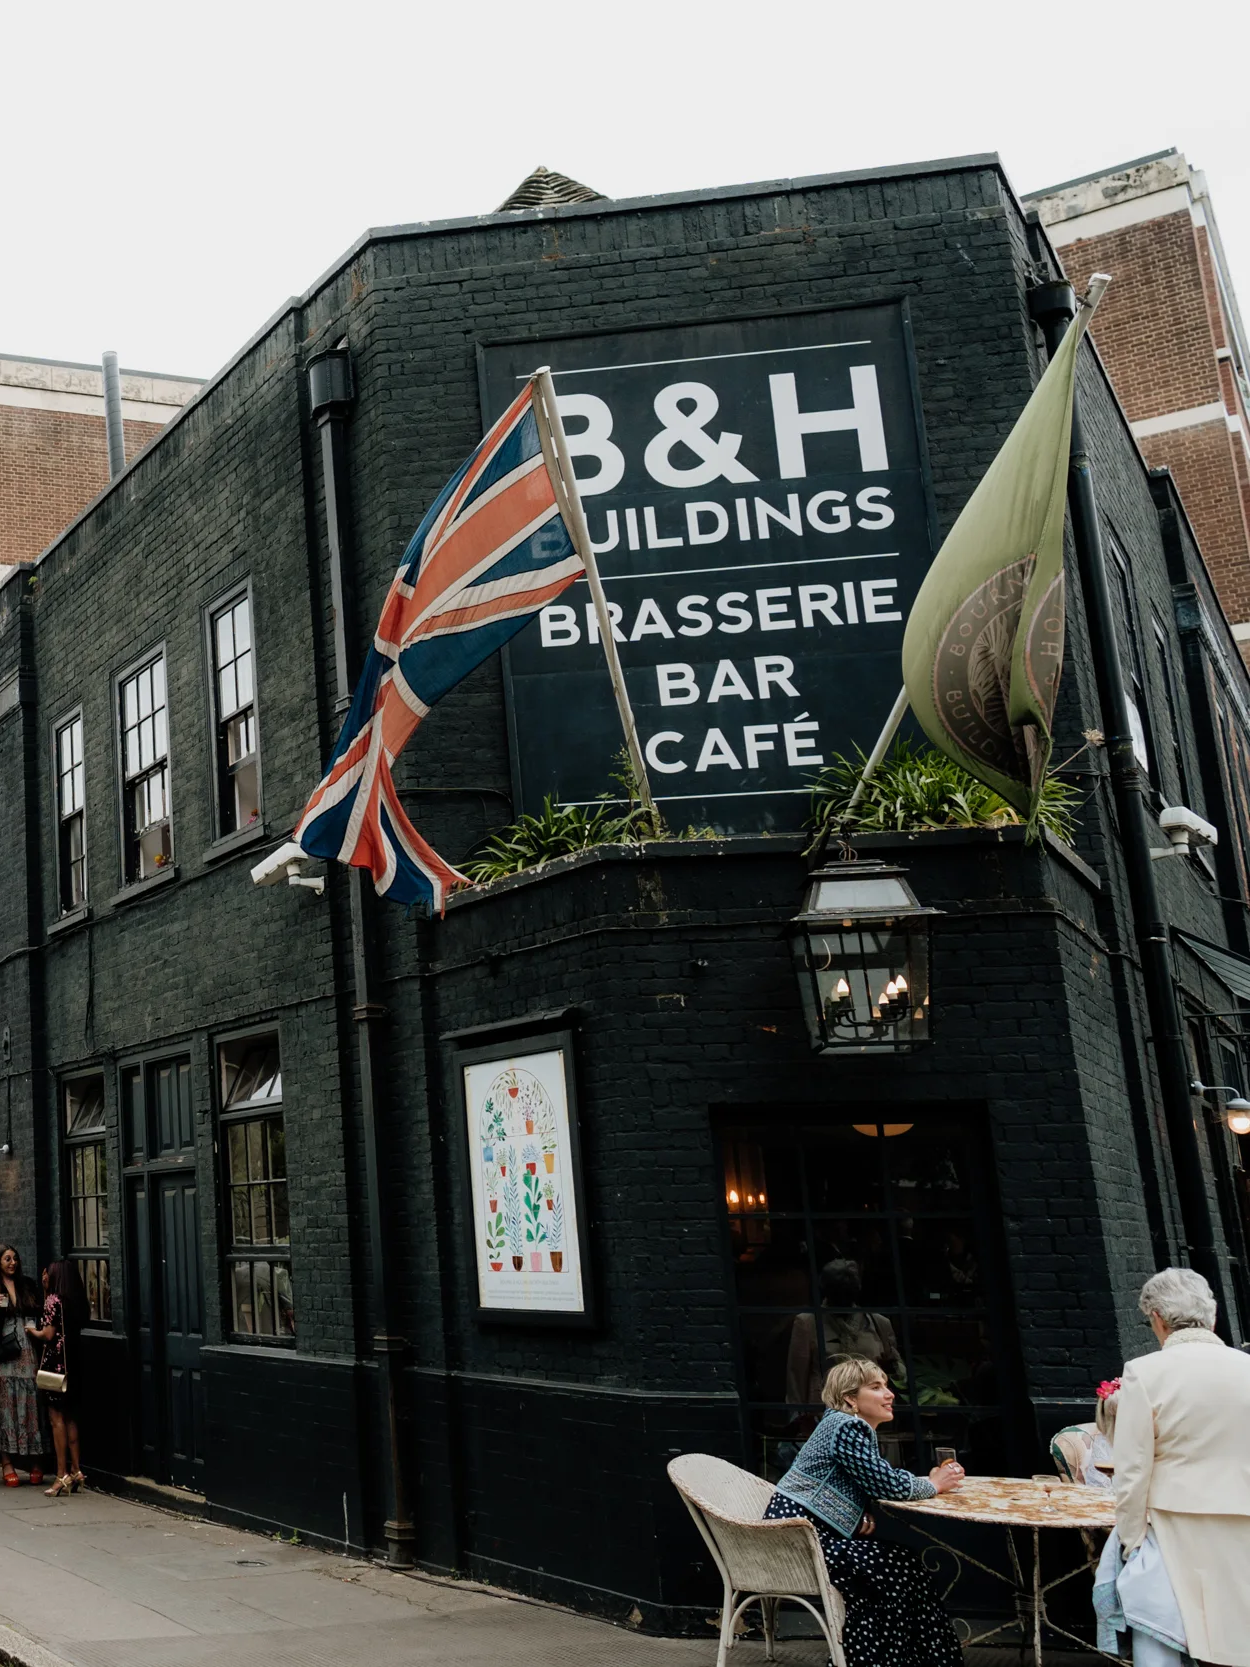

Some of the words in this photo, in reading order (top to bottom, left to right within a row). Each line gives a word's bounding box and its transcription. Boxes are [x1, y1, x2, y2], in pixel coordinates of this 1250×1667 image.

[539, 578, 902, 648] BRASSERIE
[656, 655, 800, 707] BAR
[645, 712, 824, 774] CAFÉ
